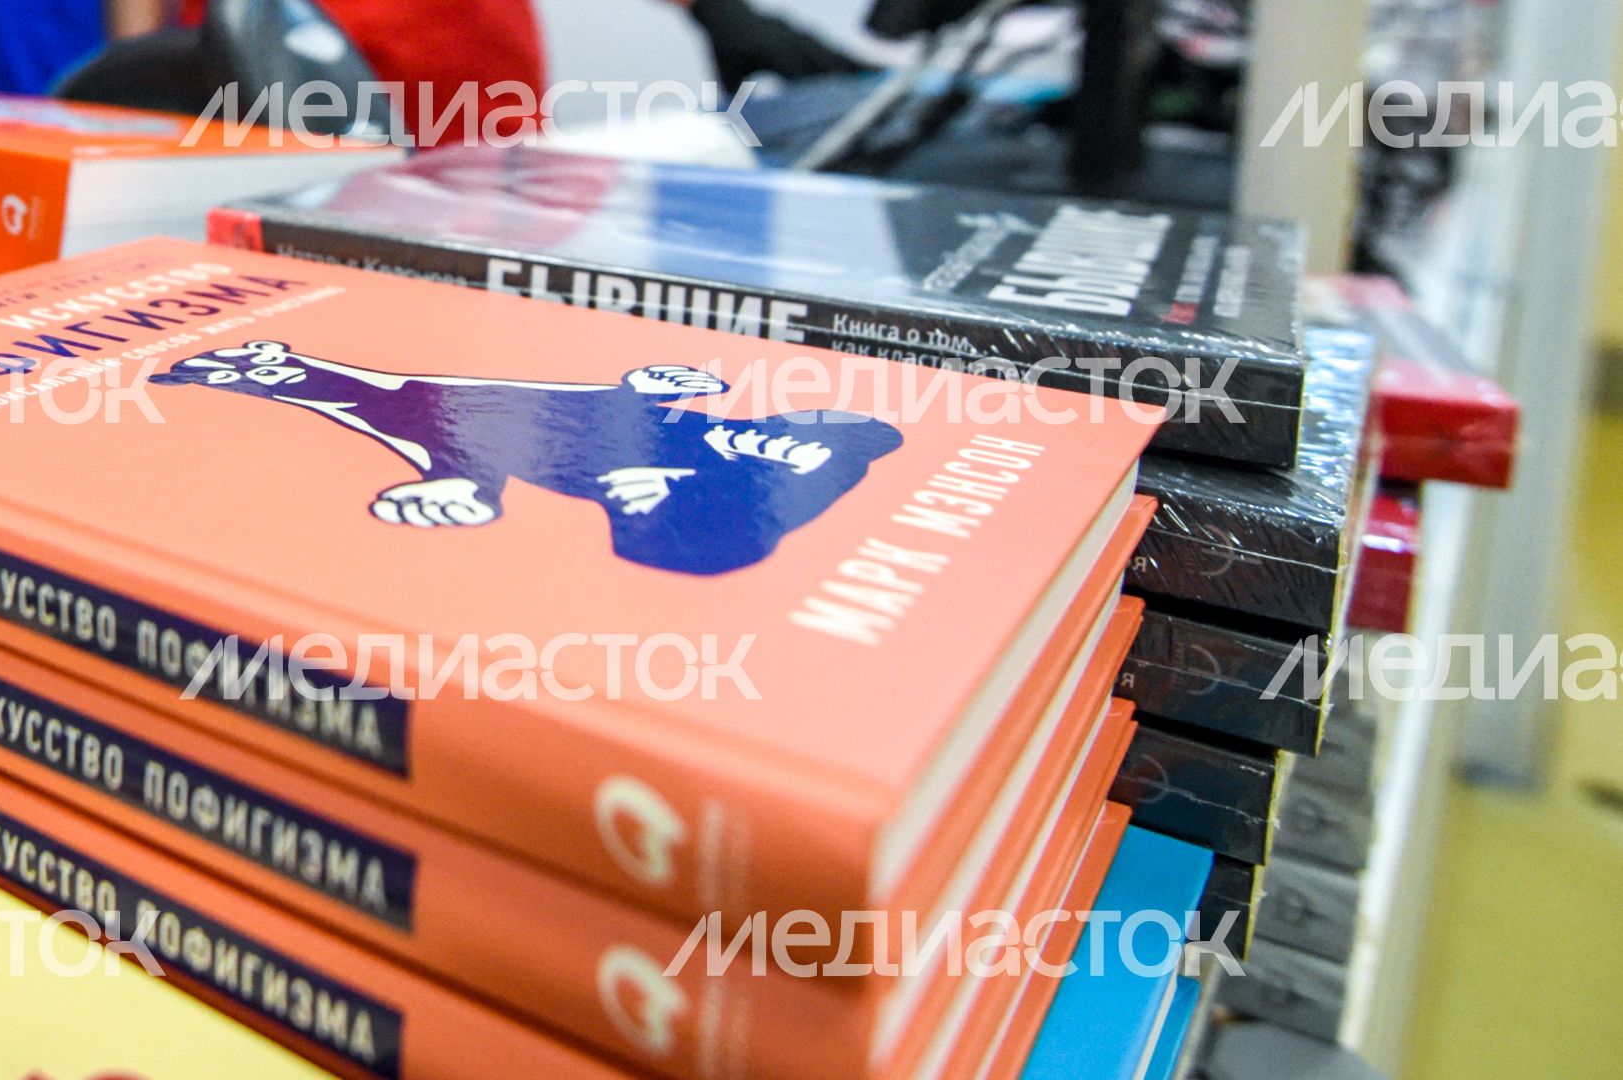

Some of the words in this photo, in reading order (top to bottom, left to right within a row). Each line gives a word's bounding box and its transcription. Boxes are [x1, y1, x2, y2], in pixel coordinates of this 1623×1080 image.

[832, 313, 899, 341] Книга
[907, 328, 920, 345] о
[789, 537, 951, 648] МАРК
[891, 432, 1045, 539] МЭНСОН
[137, 618, 384, 756] ПОФИГИЗМА
[144, 761, 389, 913] ПОФИГИЗМА
[137, 898, 377, 1063] ПОФИГИЗМА
